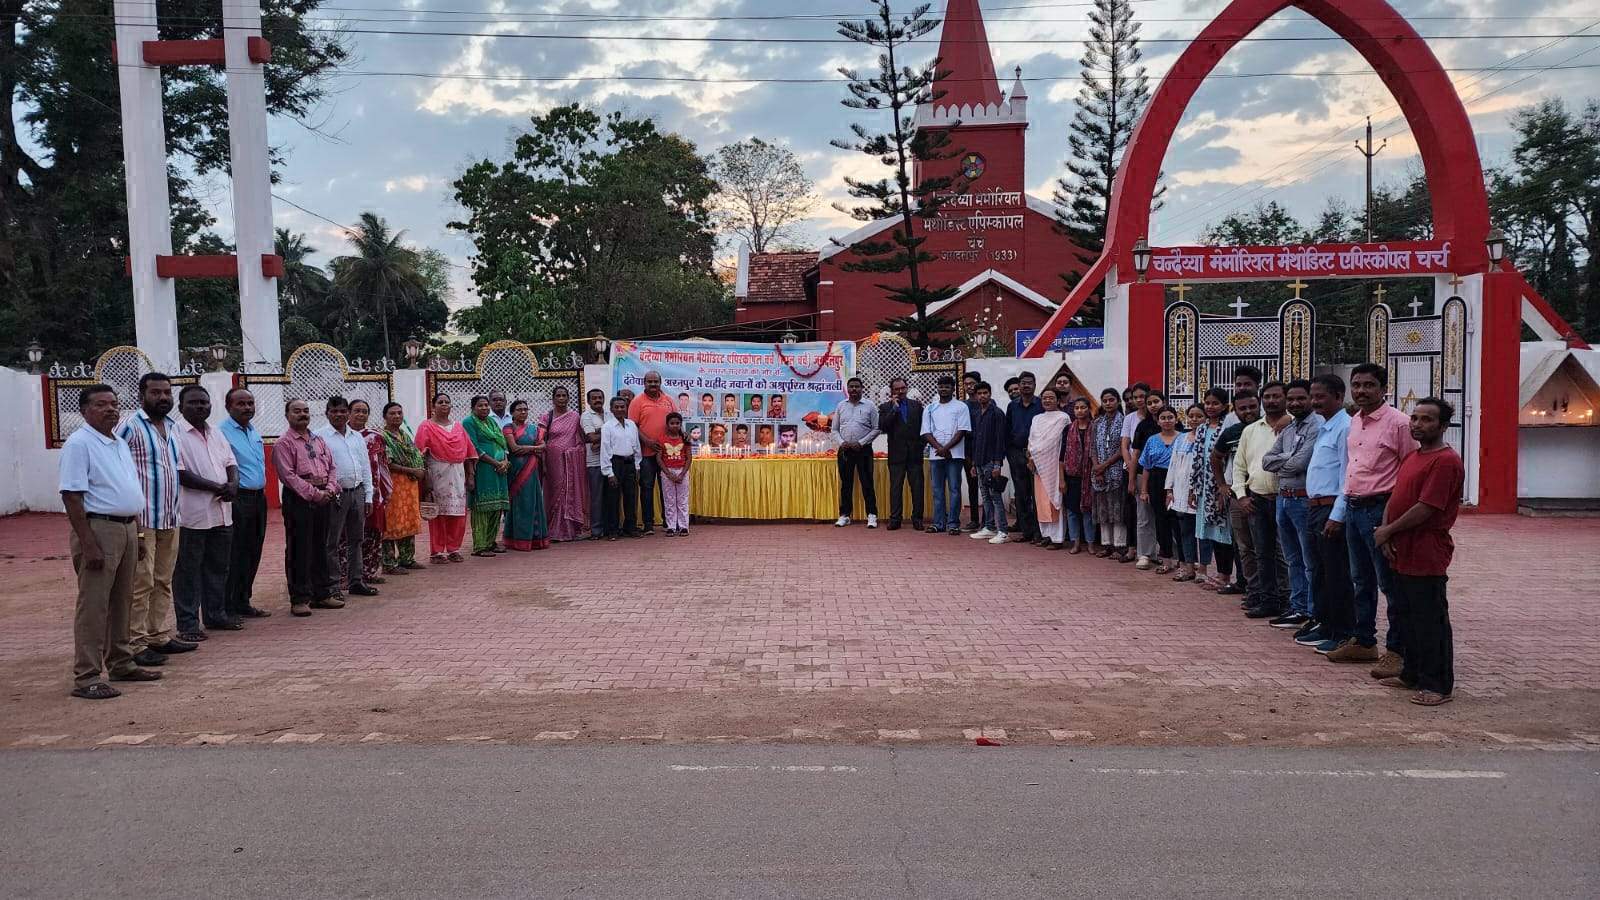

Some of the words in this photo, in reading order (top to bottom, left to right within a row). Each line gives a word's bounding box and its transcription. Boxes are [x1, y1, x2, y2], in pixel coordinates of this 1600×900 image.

[1209, 248, 1275, 272] मेमोरियल
[1277, 246, 1335, 271] मेथोडिस्ट
[1339, 245, 1411, 269] एपिस्कोपल
[1415, 242, 1451, 268] चर्च
[705, 375, 727, 389] शहीद
[755, 378, 767, 389] को
